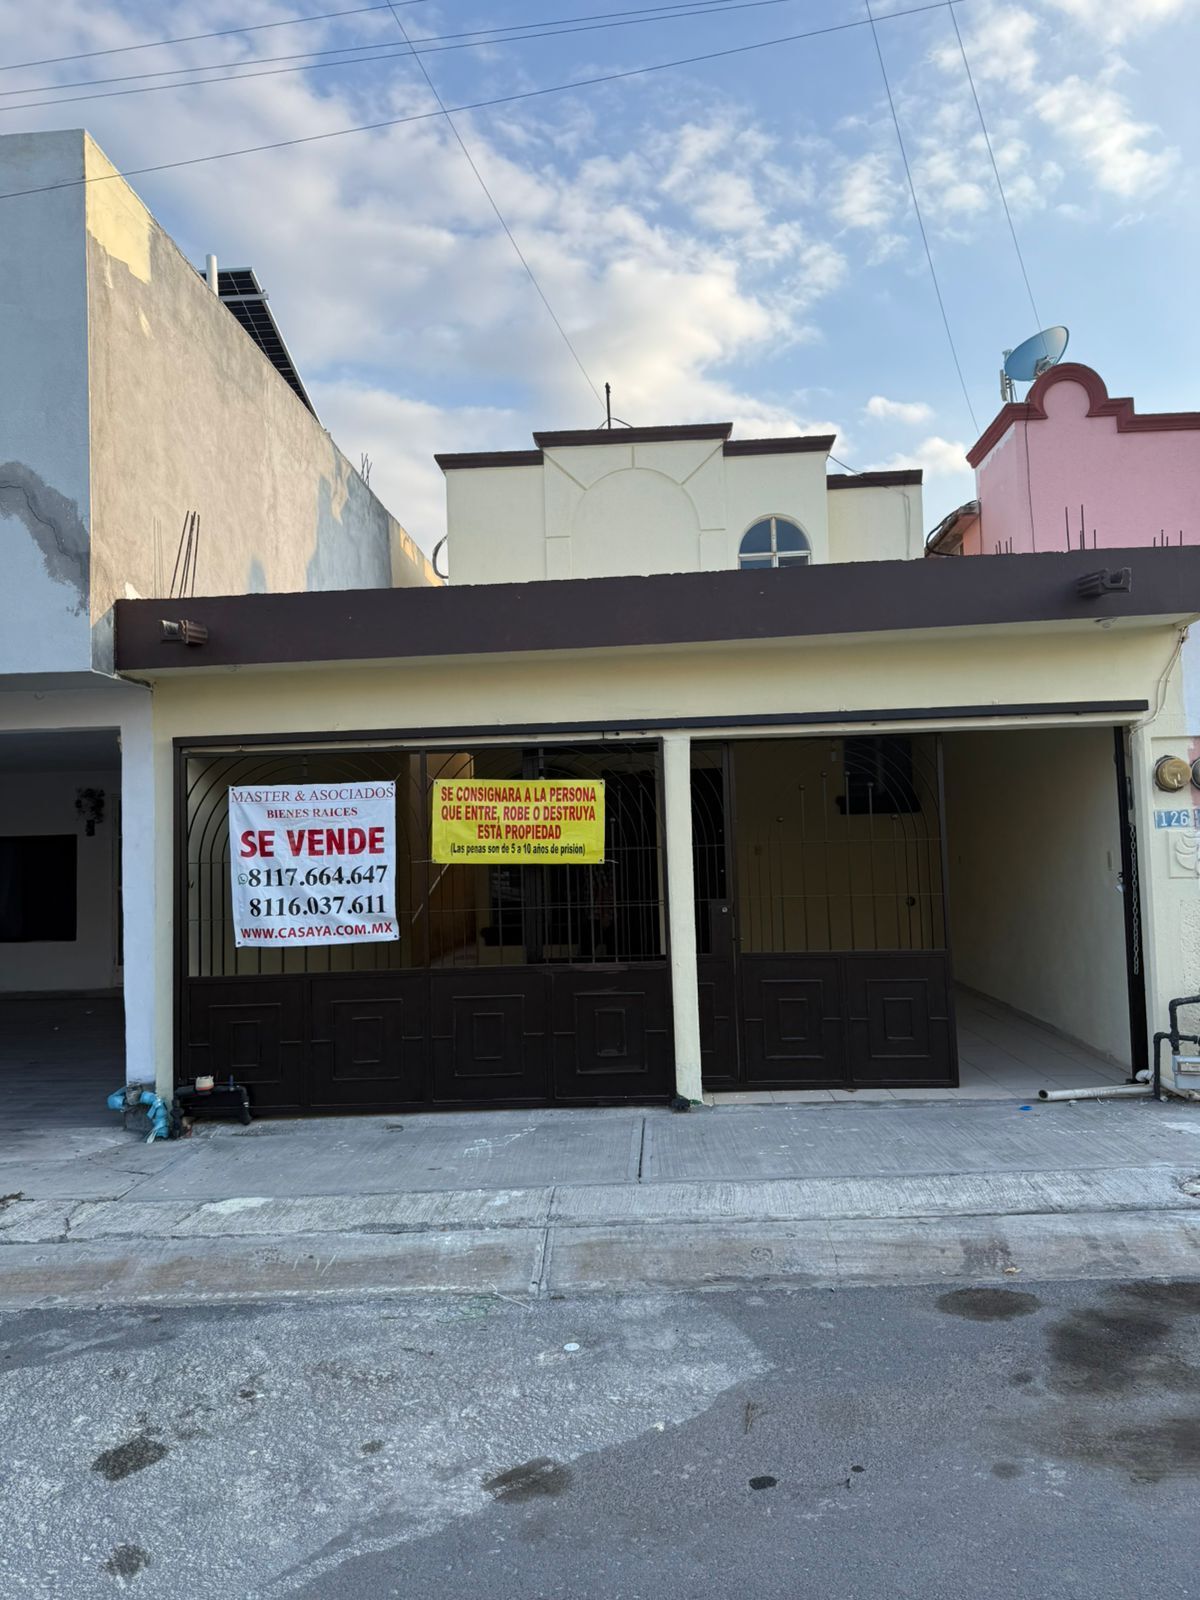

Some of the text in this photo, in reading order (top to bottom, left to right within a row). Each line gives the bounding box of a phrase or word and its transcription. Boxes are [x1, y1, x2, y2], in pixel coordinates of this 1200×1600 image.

[232, 786, 394, 803] MASTER & ASOCIADOS
[441, 786, 597, 802] SE CONSIGNARA A LA PERSONA
[266, 807, 358, 818] BIENES RAICES
[441, 805, 596, 823] QUE ENTRE, ROBE O DESTRUYA
[1160, 811, 1188, 826] 126
[477, 825, 561, 839] ESTA PROPIEDAD
[240, 827, 385, 858] SE VENDE
[450, 843, 586, 855] (Las penas son de 5 a 10 años de prisión)
[248, 865, 388, 887] 8117.664.647
[249, 895, 386, 917] 8116.037.611
[240, 922, 393, 939] WWW.CASAYA.COM.MX
